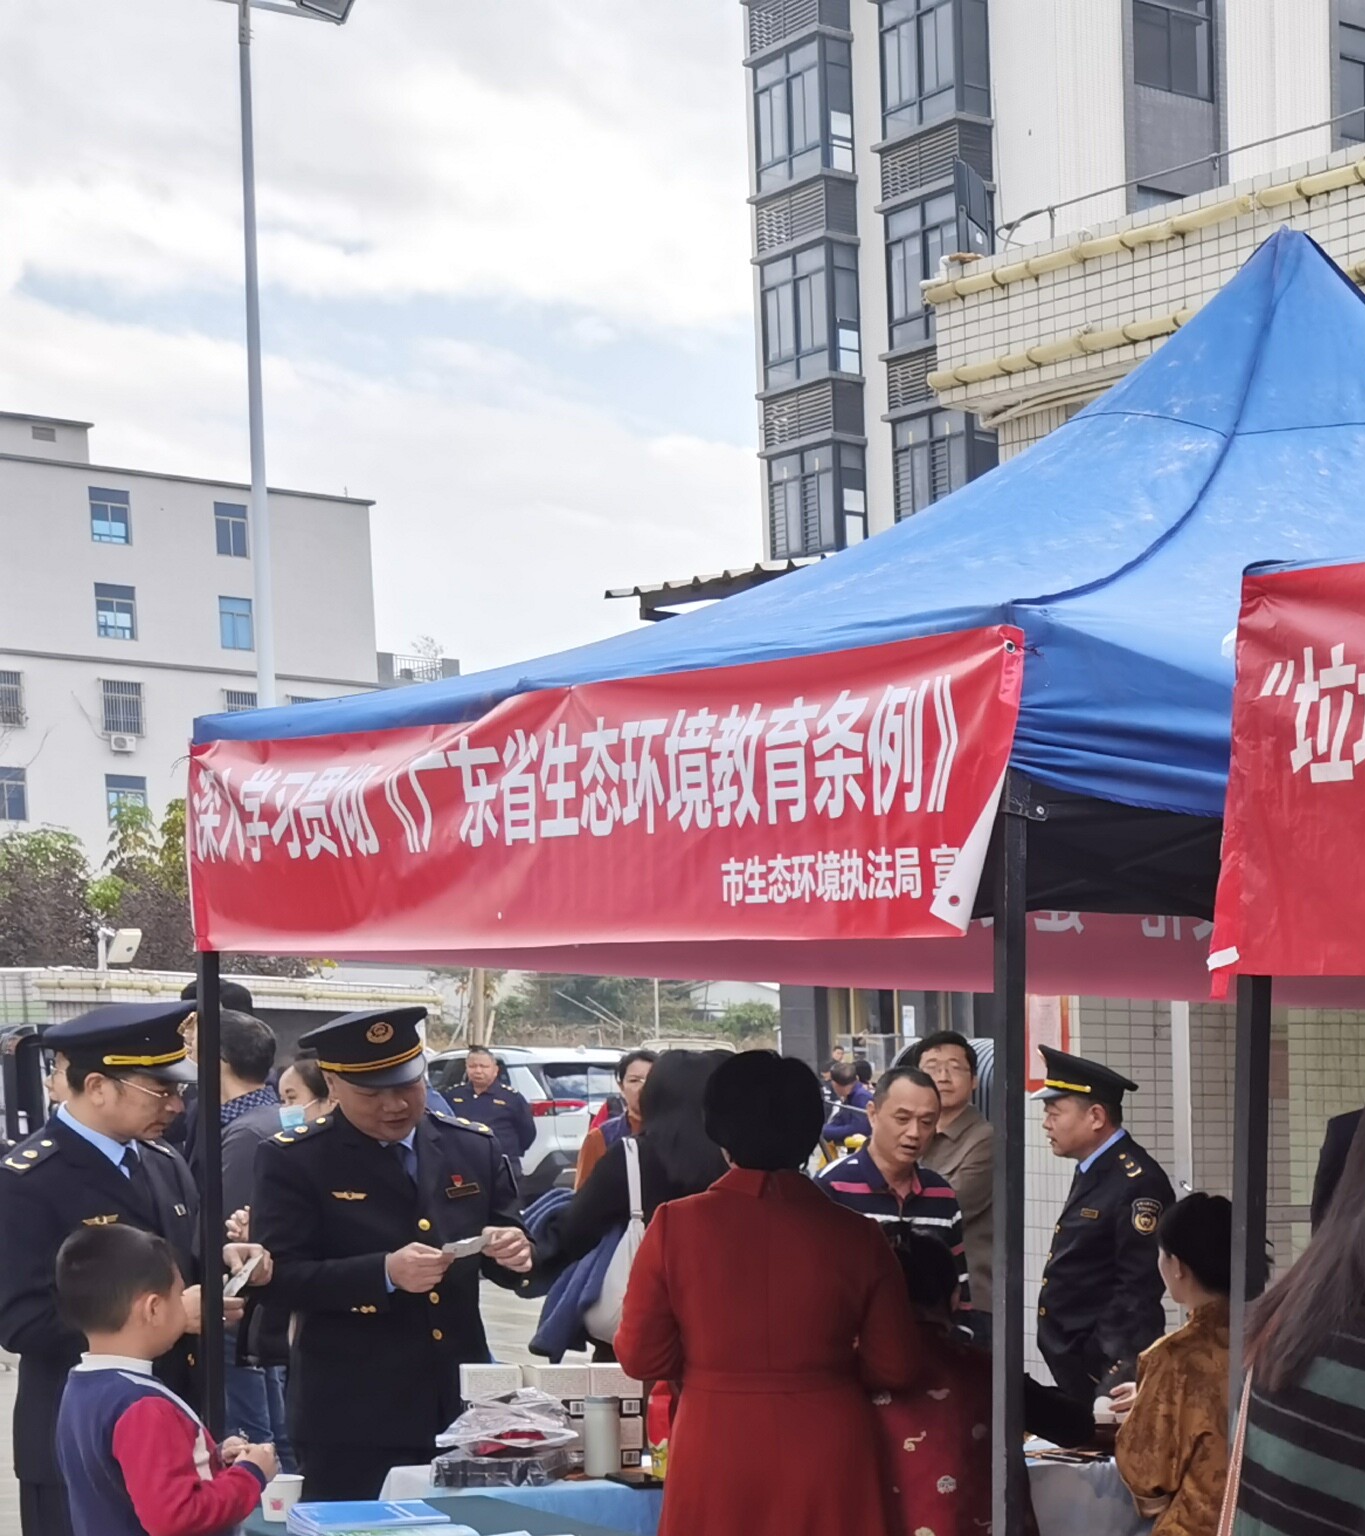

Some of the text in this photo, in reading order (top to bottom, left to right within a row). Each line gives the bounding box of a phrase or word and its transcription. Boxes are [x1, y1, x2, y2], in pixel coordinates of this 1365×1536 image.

[193, 674, 957, 863] 深入学习贯彻《广东省生态环境教育条例》
[721, 847, 922, 906] 市生态环境执法局
